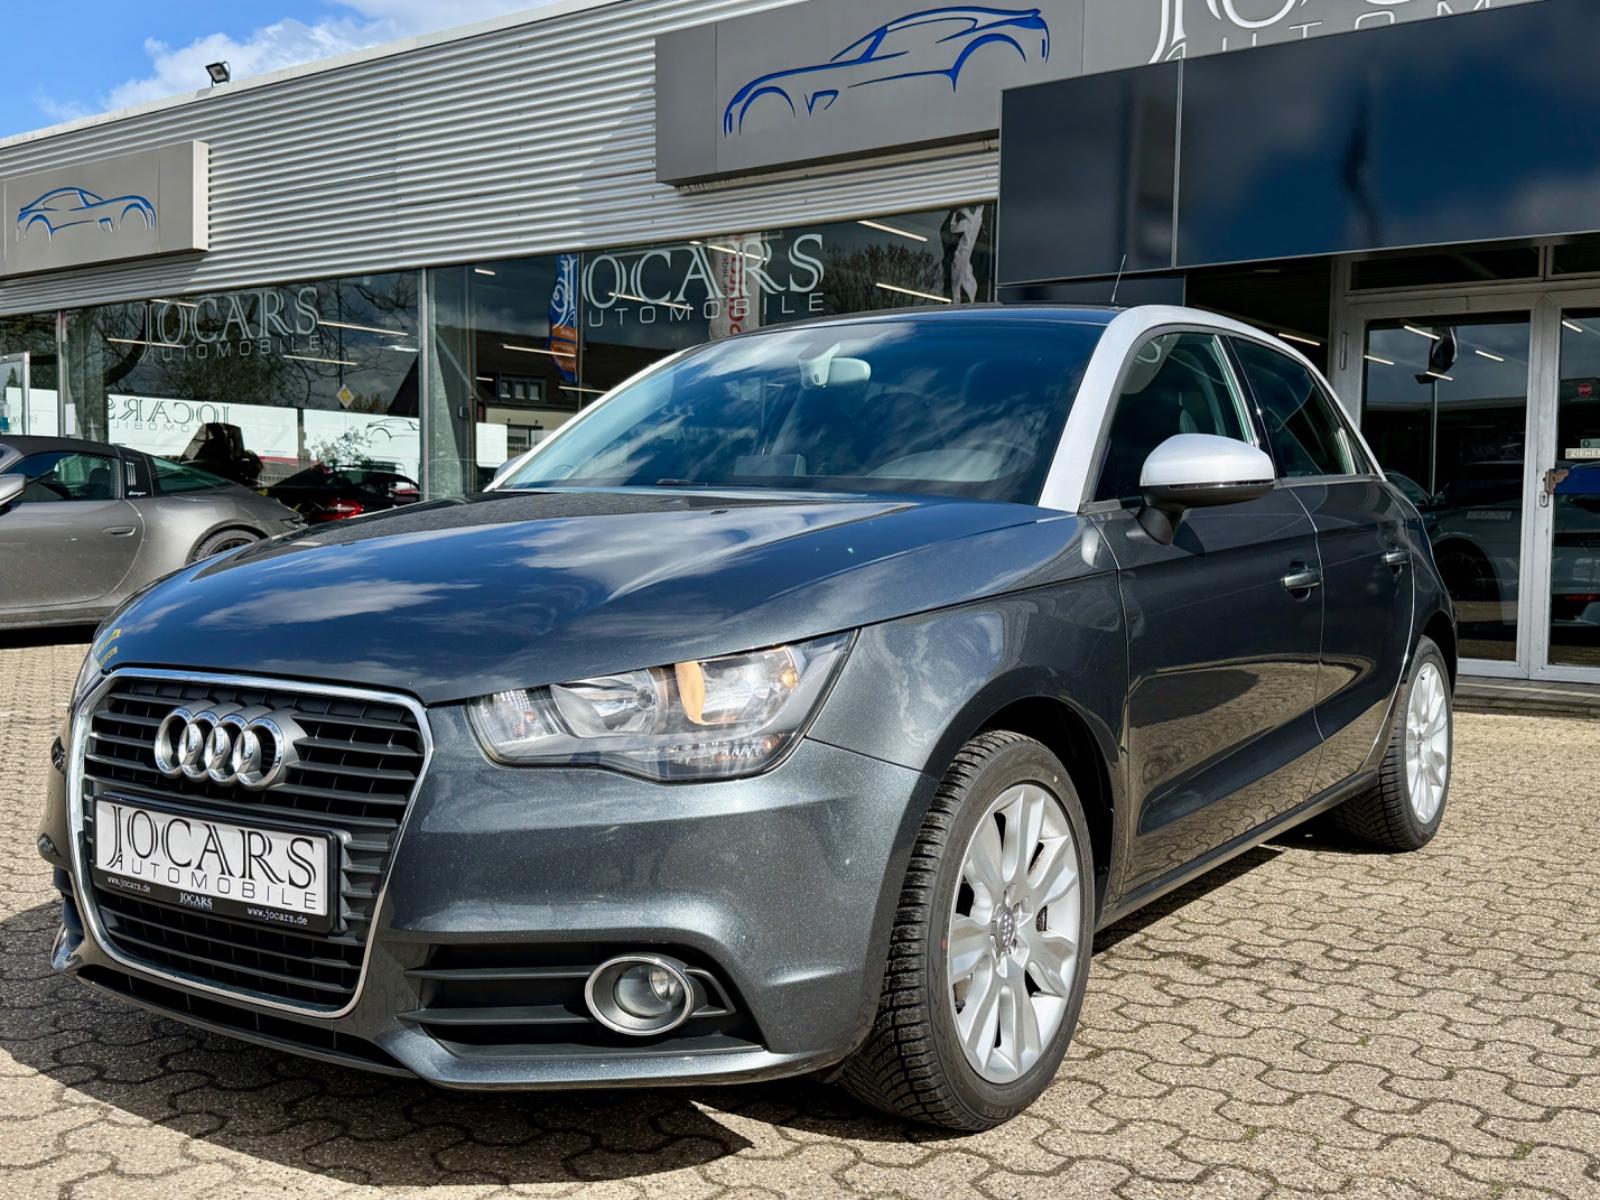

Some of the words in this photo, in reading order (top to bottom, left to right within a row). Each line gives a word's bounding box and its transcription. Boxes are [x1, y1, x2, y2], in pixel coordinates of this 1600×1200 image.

[552, 234, 824, 329] JOCARS
[138, 287, 319, 362] JOCARS
[146, 335, 320, 362] AUTOMOBILE
[106, 805, 317, 889] JOCARS
[107, 875, 151, 894] www.jocars.de
[109, 851, 317, 910] AUTOMOBILE
[180, 892, 213, 907] JOCARS
[247, 907, 308, 926] www.jocars.de
